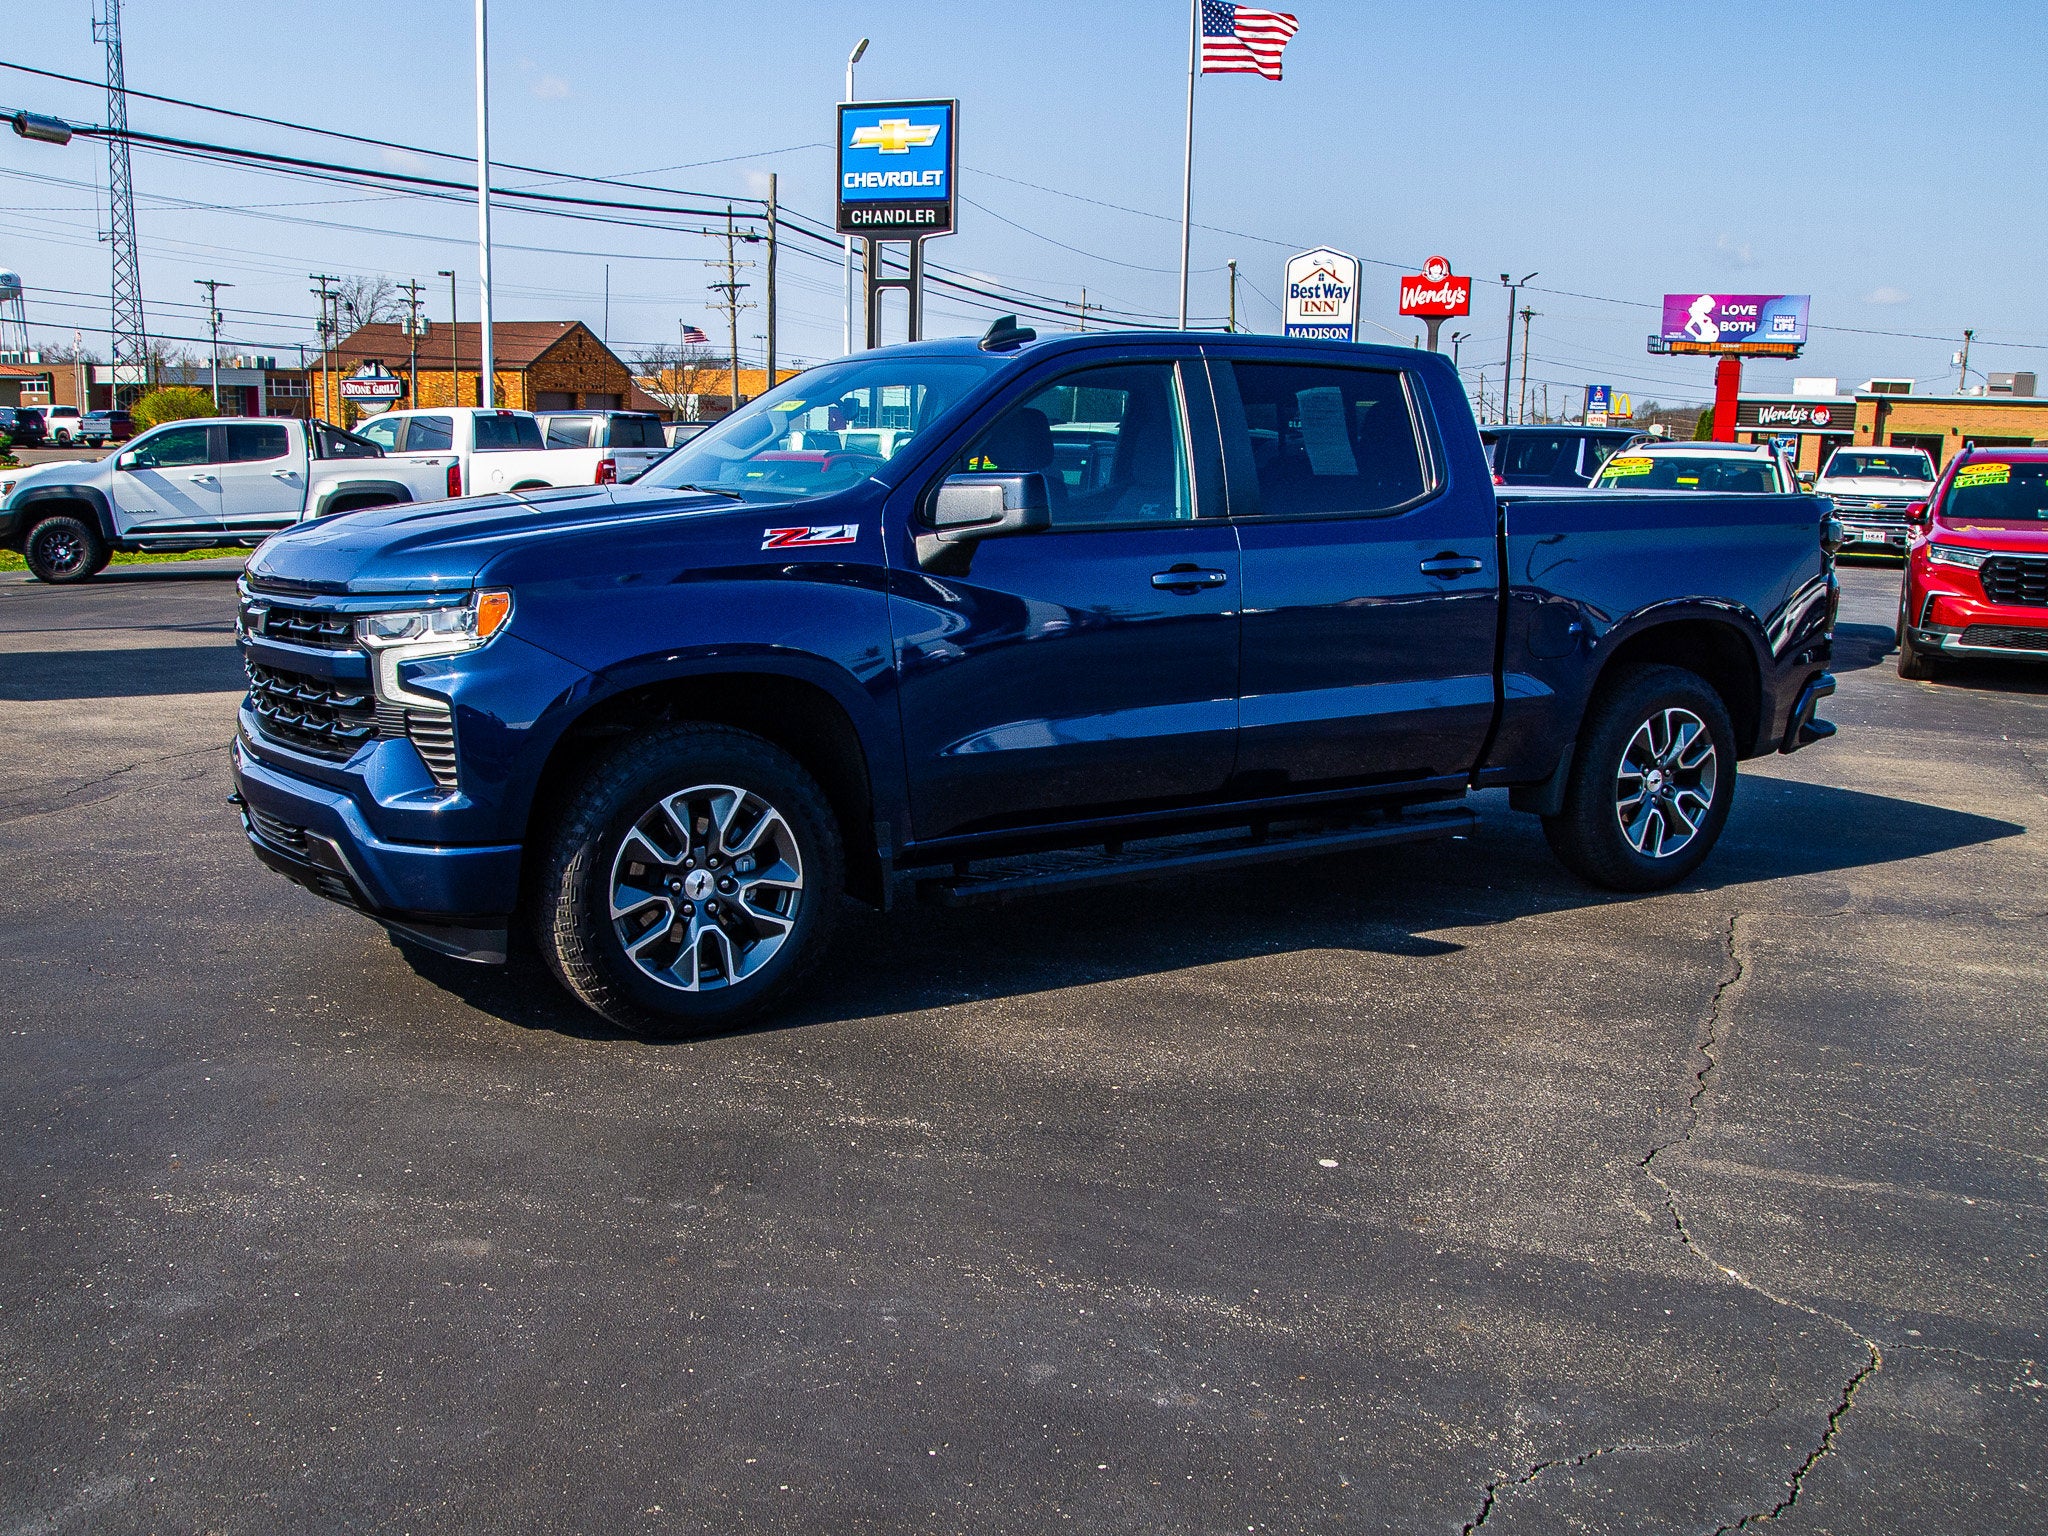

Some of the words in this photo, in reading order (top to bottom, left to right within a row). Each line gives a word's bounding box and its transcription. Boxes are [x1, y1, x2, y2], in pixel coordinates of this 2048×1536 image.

[844, 170, 944, 188] CHEVROLET
[851, 209, 935, 224] CHANDLER
[1290, 283, 1321, 299] Best
[1322, 283, 1352, 304] Way
[1402, 281, 1467, 310] Wendy's
[1303, 300, 1336, 312] INN
[1721, 304, 1758, 316] LOVE
[1288, 327, 1350, 340] MADISON
[1719, 321, 1756, 332] BOTH
[345, 382, 372, 395] STONE
[372, 383, 397, 395] GRILL
[1758, 404, 1809, 425] Wendy's
[761, 524, 859, 550] Z71
